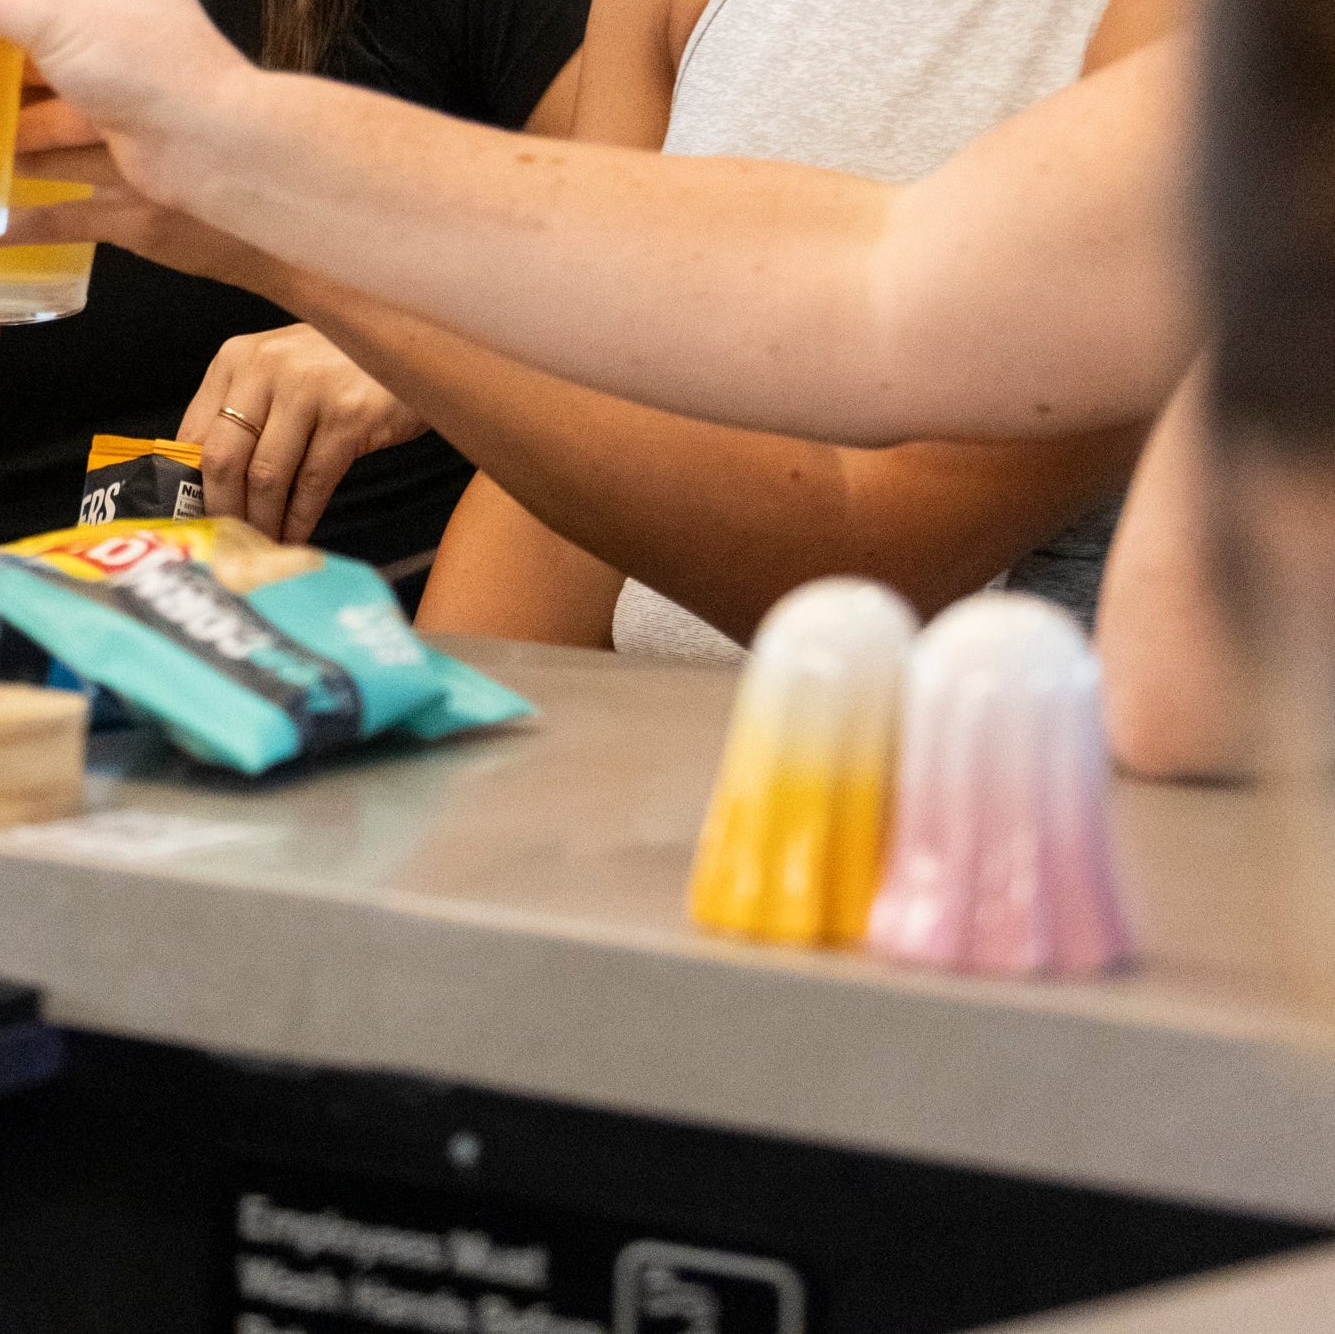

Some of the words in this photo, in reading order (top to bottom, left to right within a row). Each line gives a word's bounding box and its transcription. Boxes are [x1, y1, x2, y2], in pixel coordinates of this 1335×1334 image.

[239, 1193, 443, 1270] Employees
[448, 1229, 549, 1287] Must
[237, 1254, 342, 1310] Wash
[351, 1279, 471, 1330] Hands
